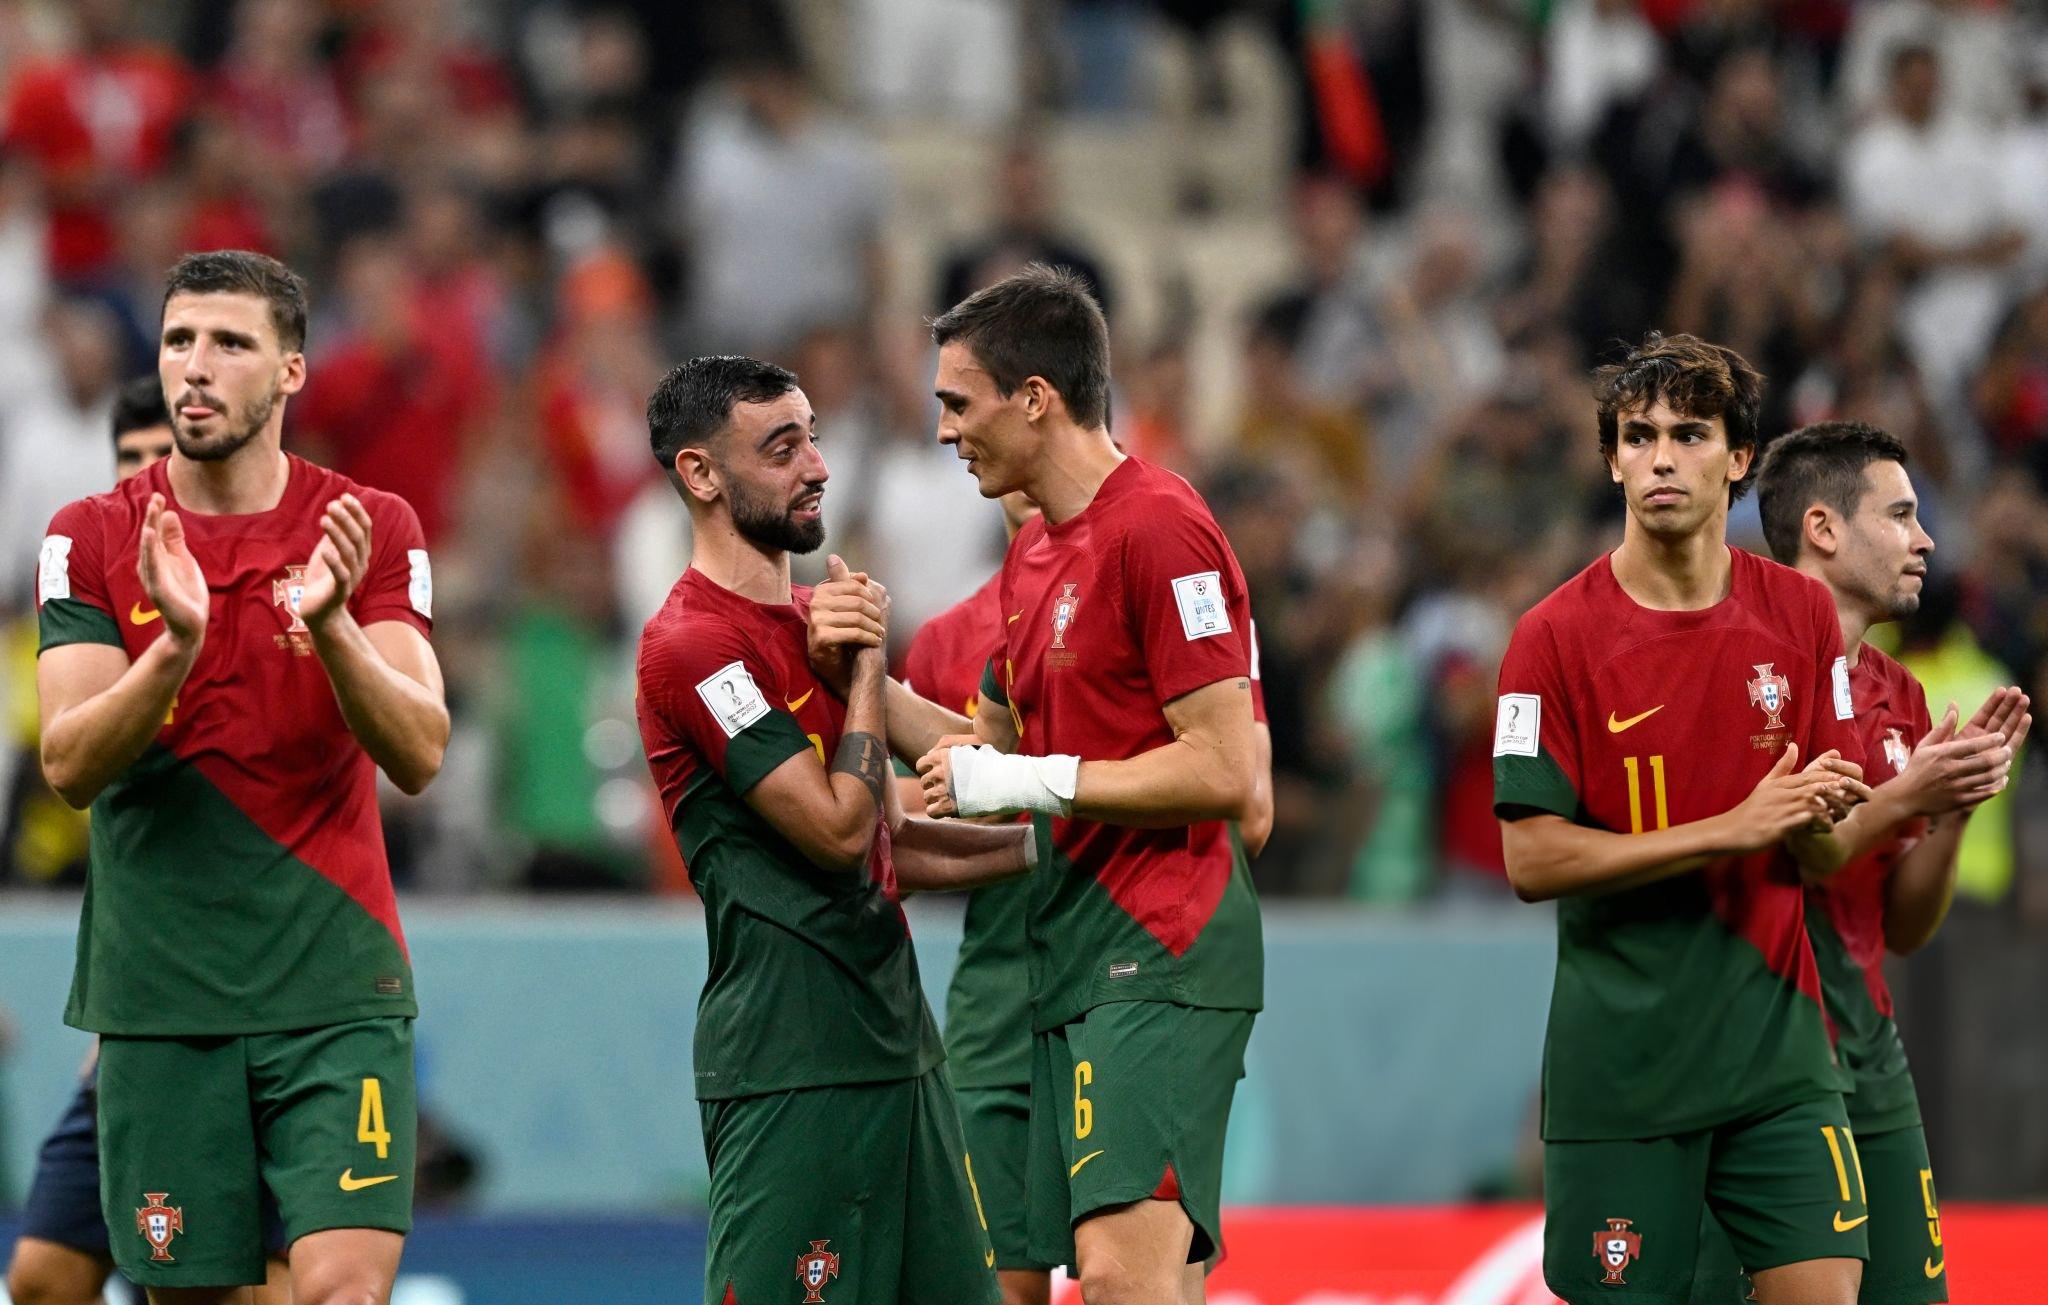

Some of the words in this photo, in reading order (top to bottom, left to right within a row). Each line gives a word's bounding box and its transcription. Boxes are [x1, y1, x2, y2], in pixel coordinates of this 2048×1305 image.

[1623, 755, 1669, 834] 11
[357, 1078, 391, 1158] 4
[1074, 1060, 1093, 1139] 6
[1820, 1125, 1867, 1205] 11
[1920, 1168, 1943, 1247] 5
